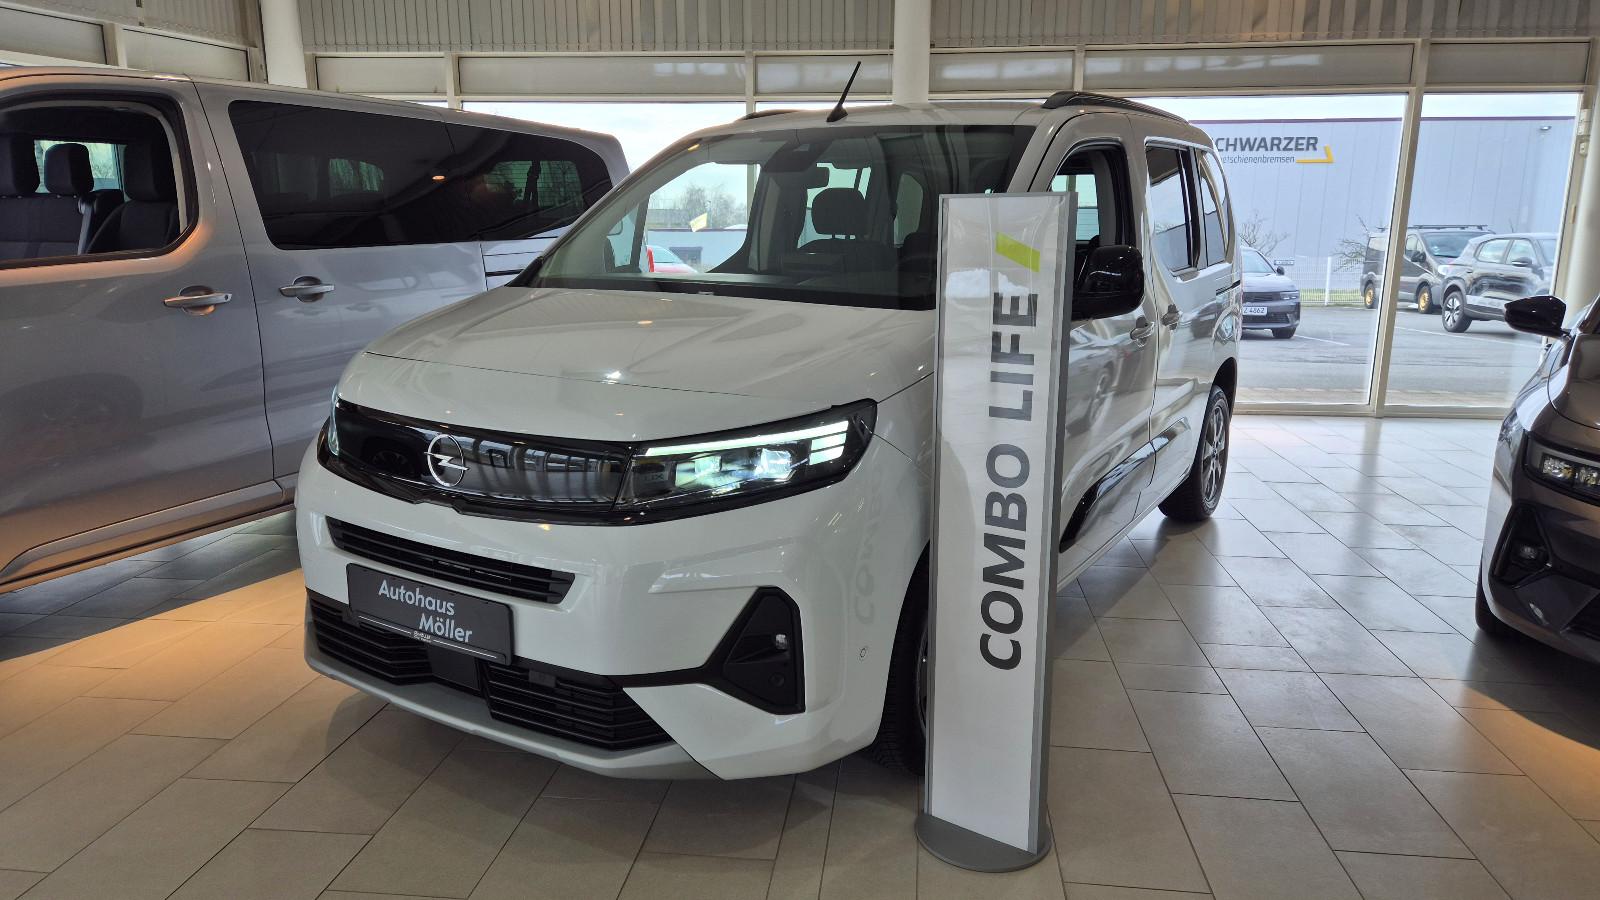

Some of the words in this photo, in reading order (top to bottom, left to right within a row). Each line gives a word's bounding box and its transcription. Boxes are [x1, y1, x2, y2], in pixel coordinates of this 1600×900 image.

[1212, 136, 1318, 152] CHWARZER
[989, 291, 1039, 422] LIFE
[979, 443, 1030, 670] COMBO
[378, 579, 455, 616] Autohaus
[418, 613, 473, 643] Möller
